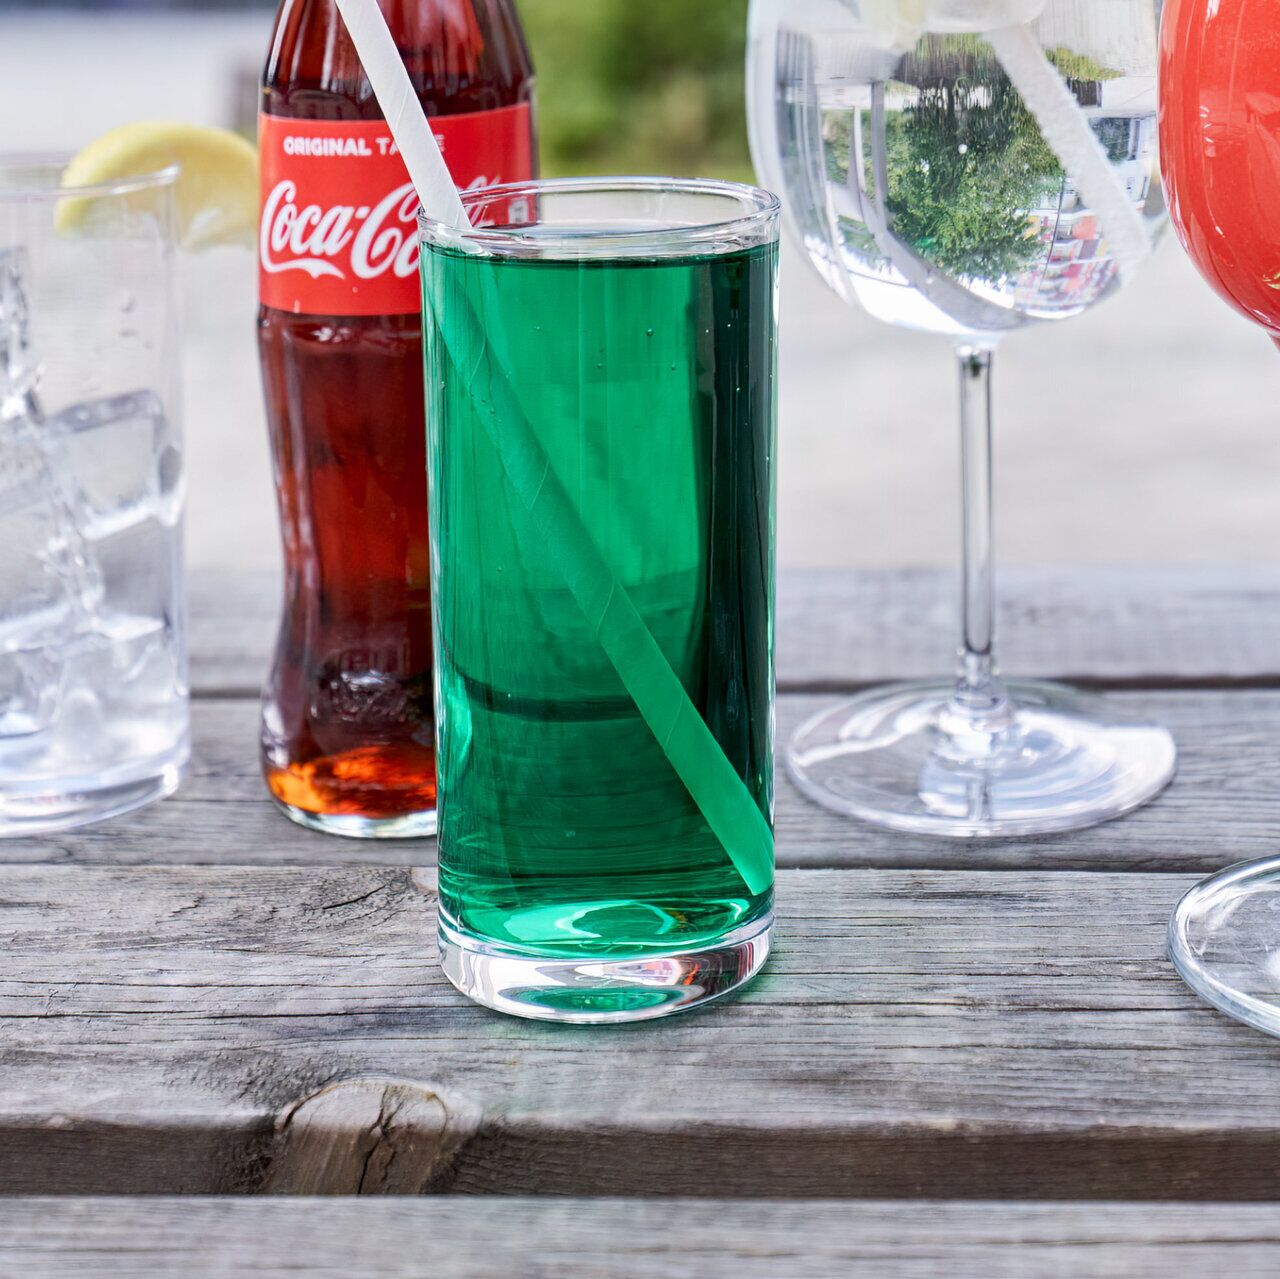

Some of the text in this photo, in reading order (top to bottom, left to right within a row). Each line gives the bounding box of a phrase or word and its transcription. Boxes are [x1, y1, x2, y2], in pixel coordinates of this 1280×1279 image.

[283, 134, 445, 156] ORIGINAL TAE
[261, 176, 500, 279] Coca-Co
